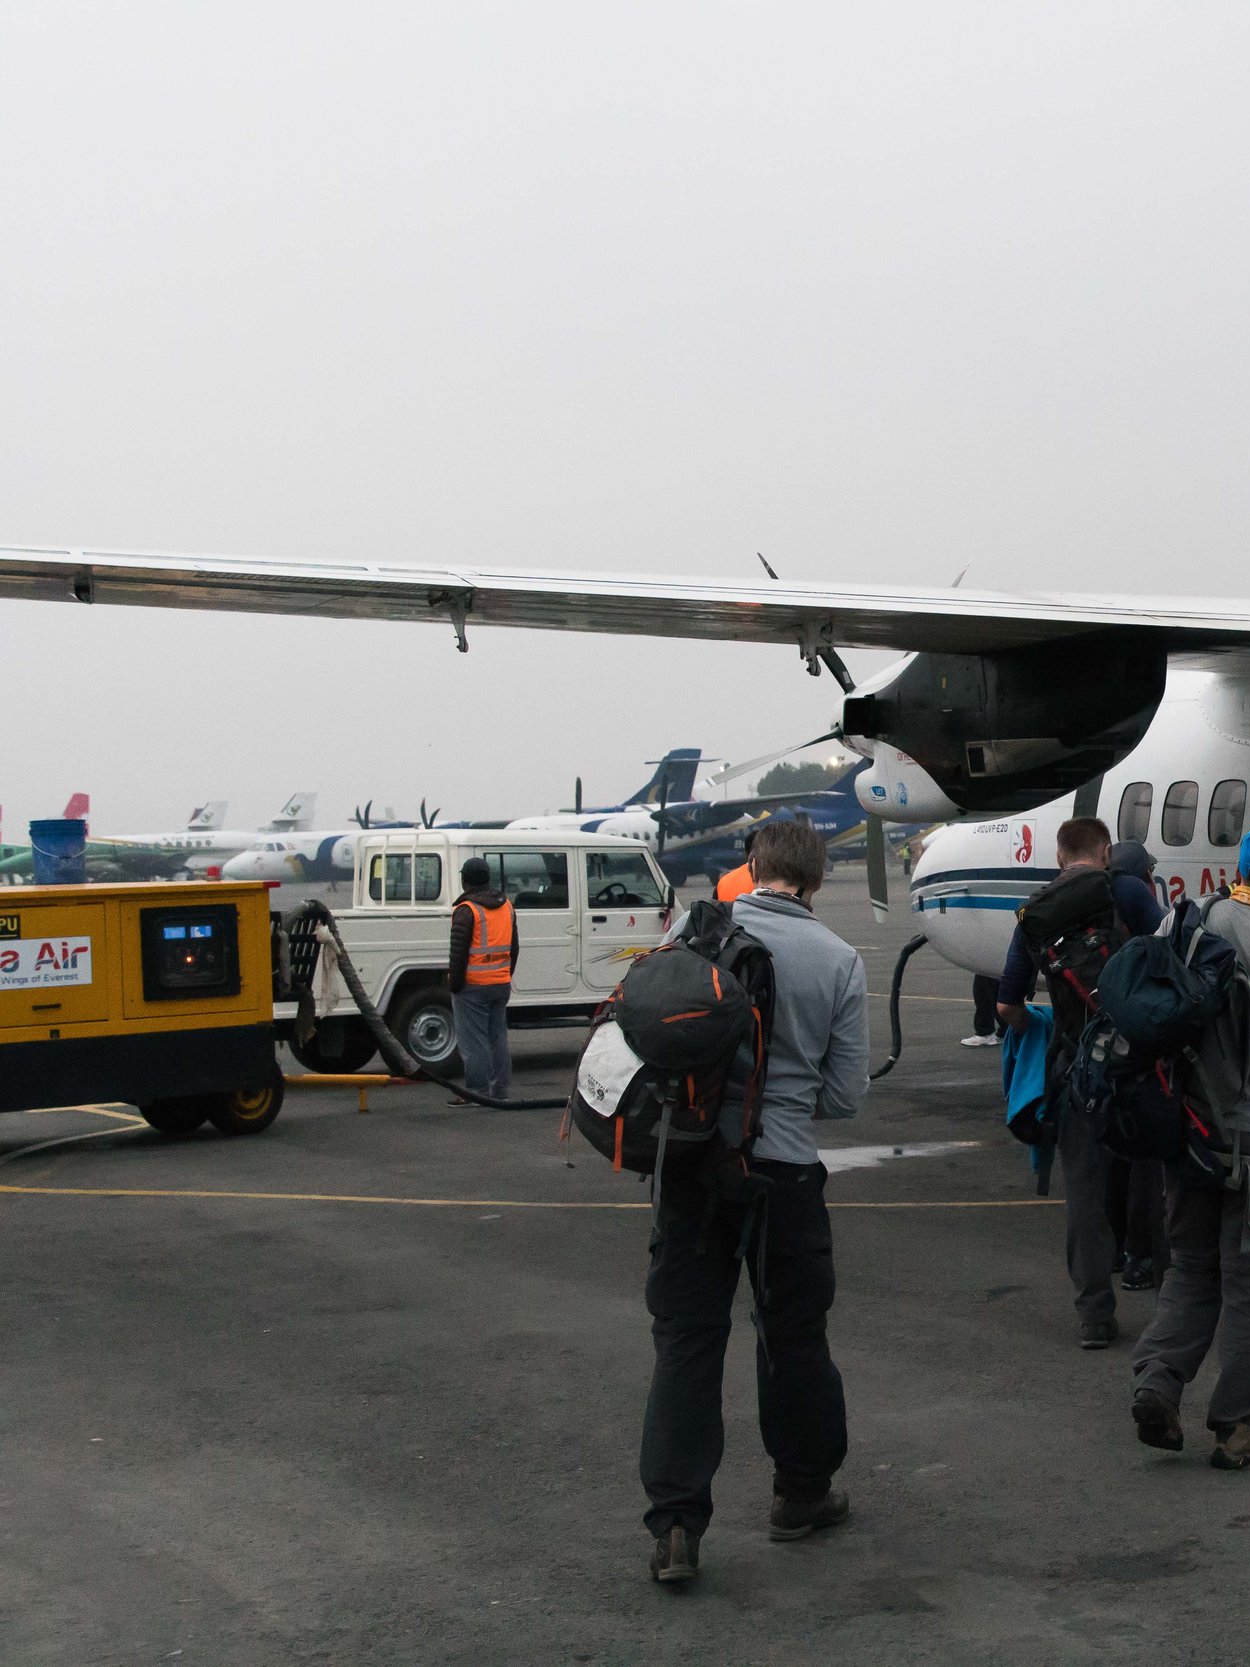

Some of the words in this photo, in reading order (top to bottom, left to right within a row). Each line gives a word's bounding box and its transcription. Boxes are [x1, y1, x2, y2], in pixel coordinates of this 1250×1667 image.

[35, 941, 89, 971] Air
[1, 975, 29, 986] Wings
[31, 974, 41, 983] of
[43, 972, 79, 983] Everest
